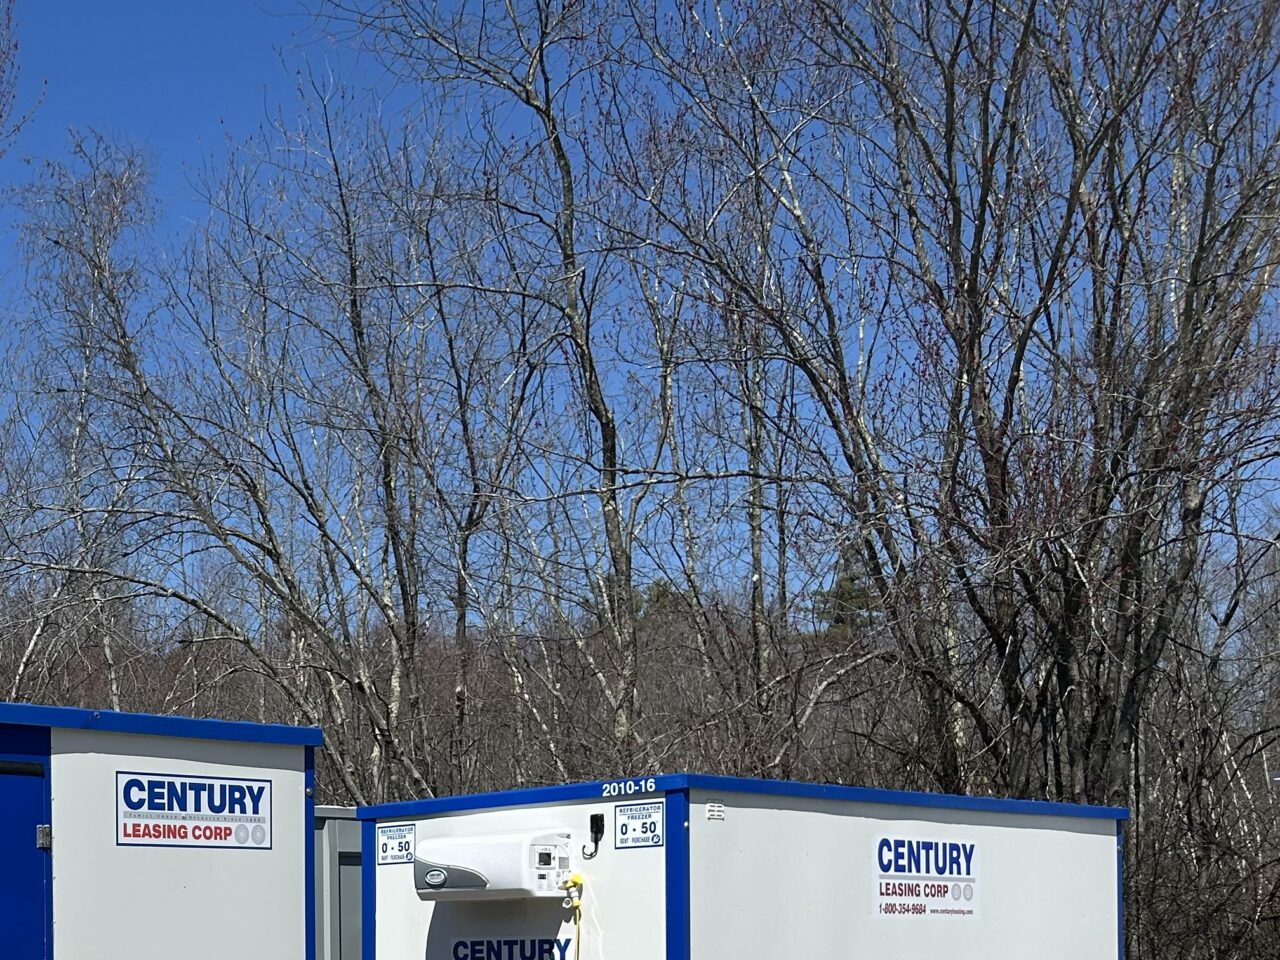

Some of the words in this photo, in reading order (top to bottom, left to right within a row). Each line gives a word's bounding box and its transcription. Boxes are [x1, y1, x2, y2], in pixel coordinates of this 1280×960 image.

[123, 778, 266, 815] CENTURY
[602, 778, 656, 797] 2010-16
[619, 805, 661, 813] REFRIGERATOR
[123, 822, 188, 840] LEASING
[191, 825, 233, 840] CORP
[877, 838, 975, 876] CENTURY
[879, 882, 921, 898] LEASING
[923, 883, 949, 898] CORP
